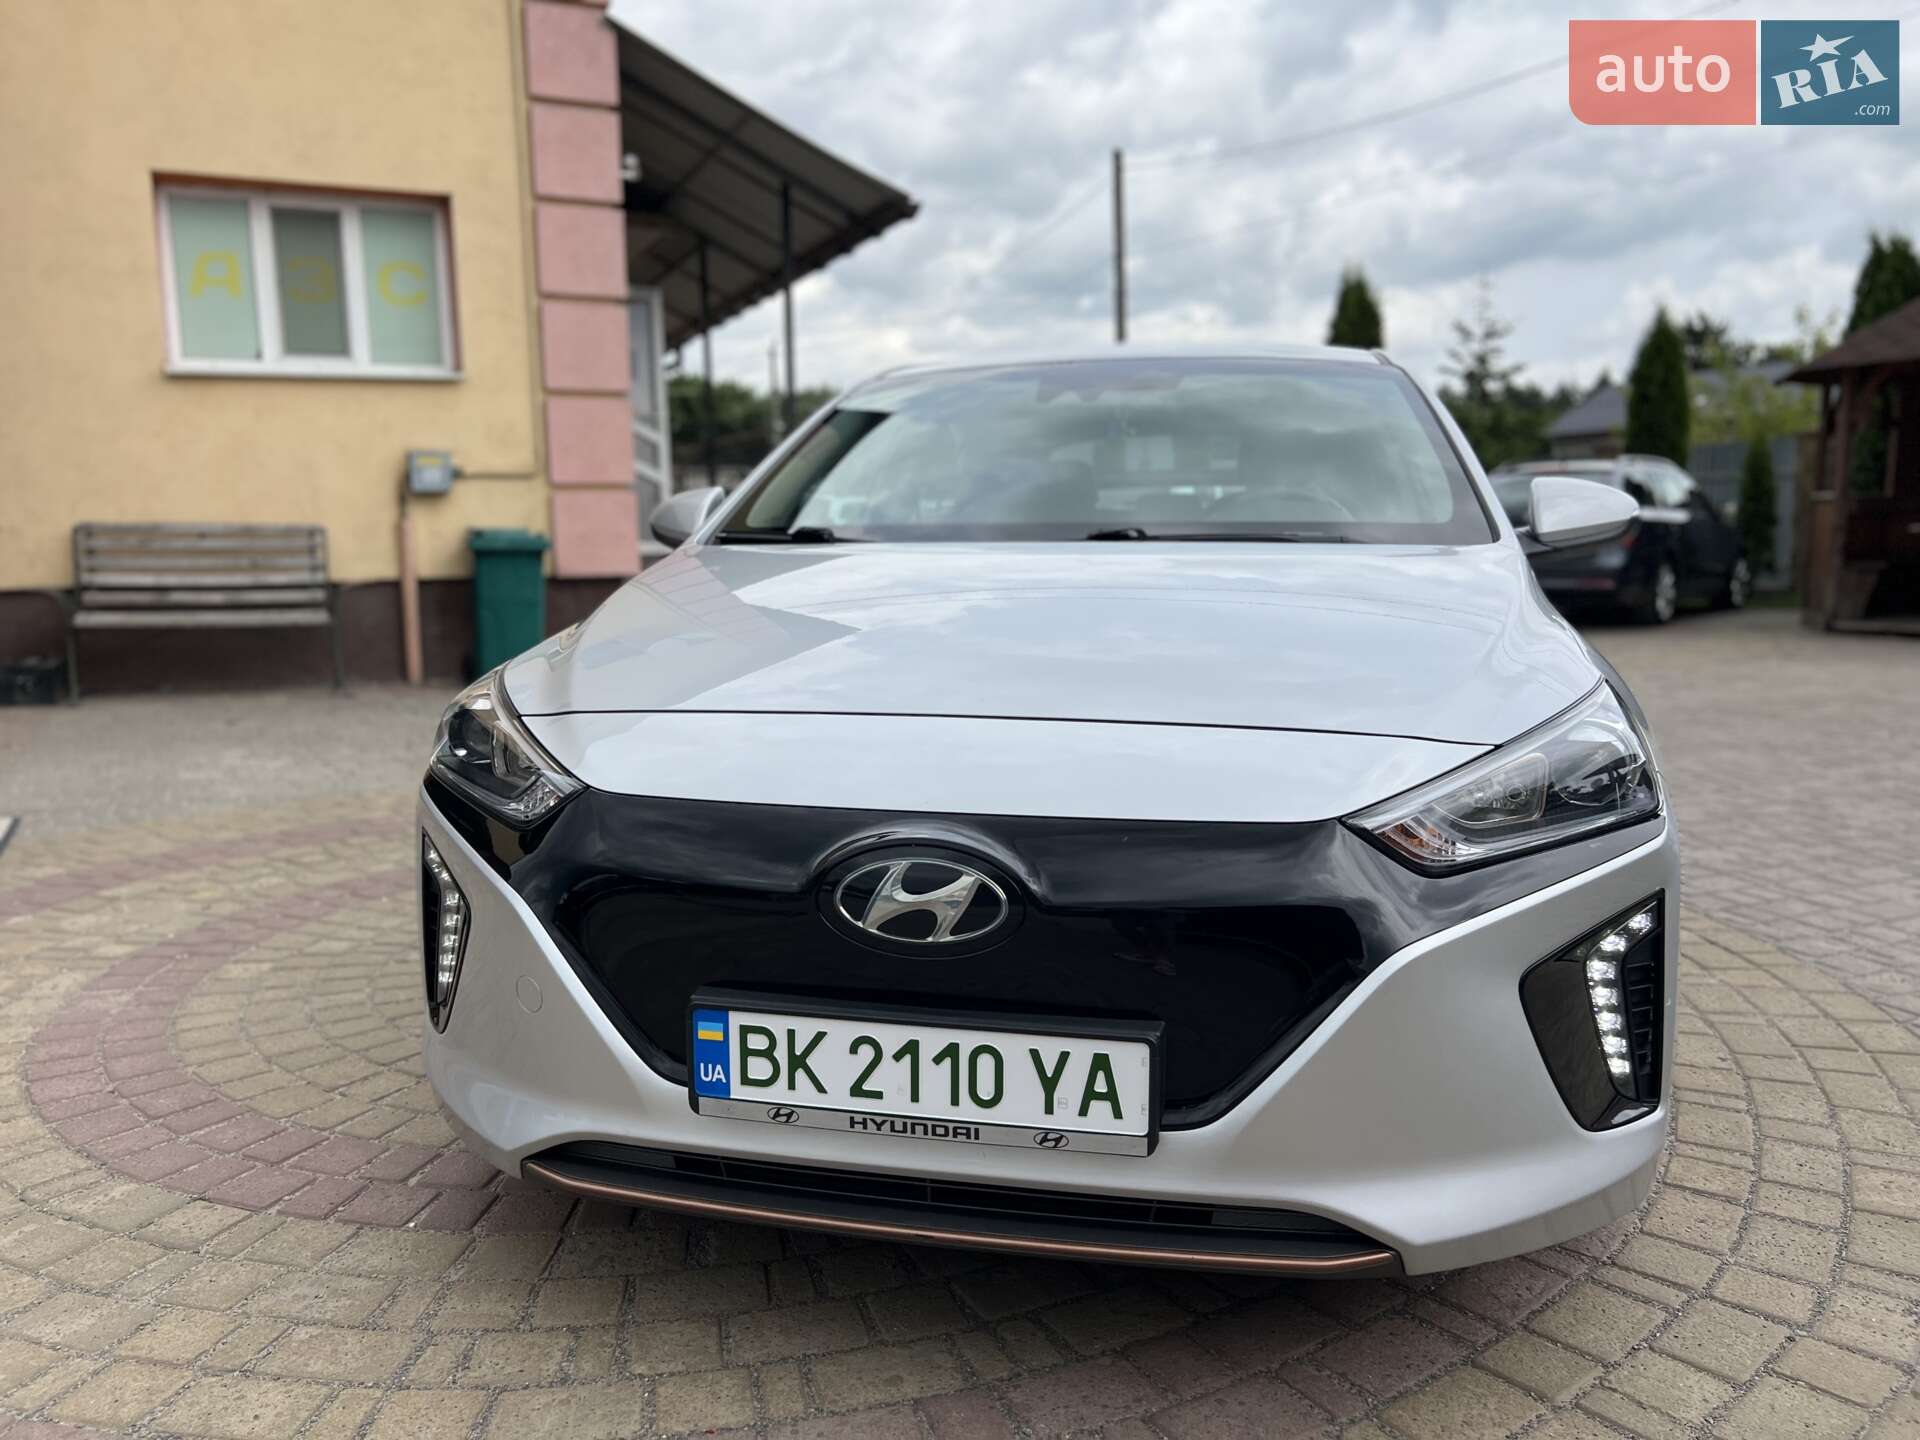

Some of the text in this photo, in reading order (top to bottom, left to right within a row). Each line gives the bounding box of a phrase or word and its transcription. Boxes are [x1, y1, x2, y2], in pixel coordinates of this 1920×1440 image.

[700, 1062, 726, 1084] UA
[738, 1024, 1124, 1120] BK 2110 YA
[849, 1115, 980, 1142] HYUNDAI
